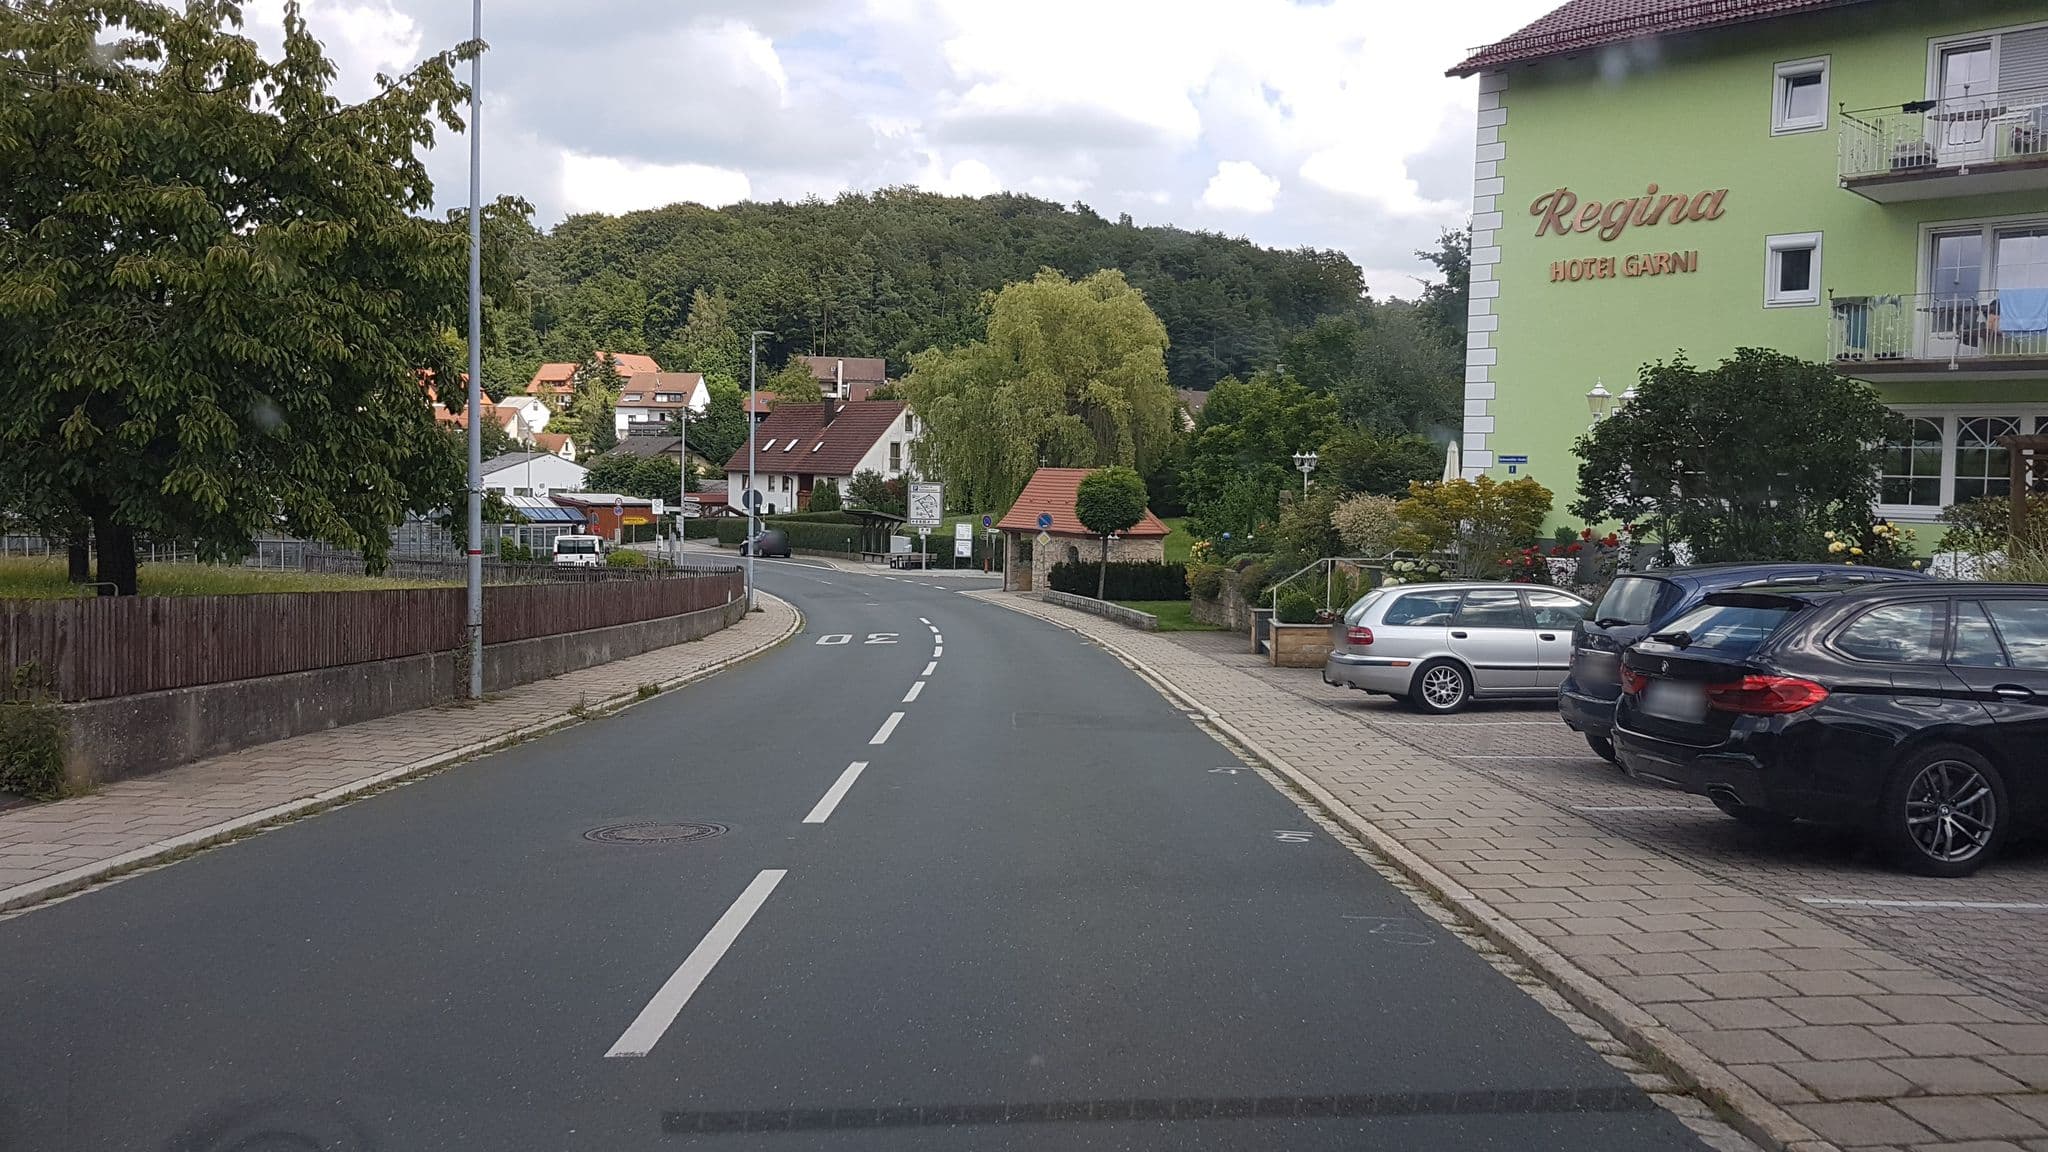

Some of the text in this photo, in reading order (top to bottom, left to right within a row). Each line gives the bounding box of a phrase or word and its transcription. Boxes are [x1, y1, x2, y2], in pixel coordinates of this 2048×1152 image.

[1529, 183, 1729, 241] Regina
[1550, 250, 1698, 282] HOTEL GARNI
[815, 633, 899, 645] 30
